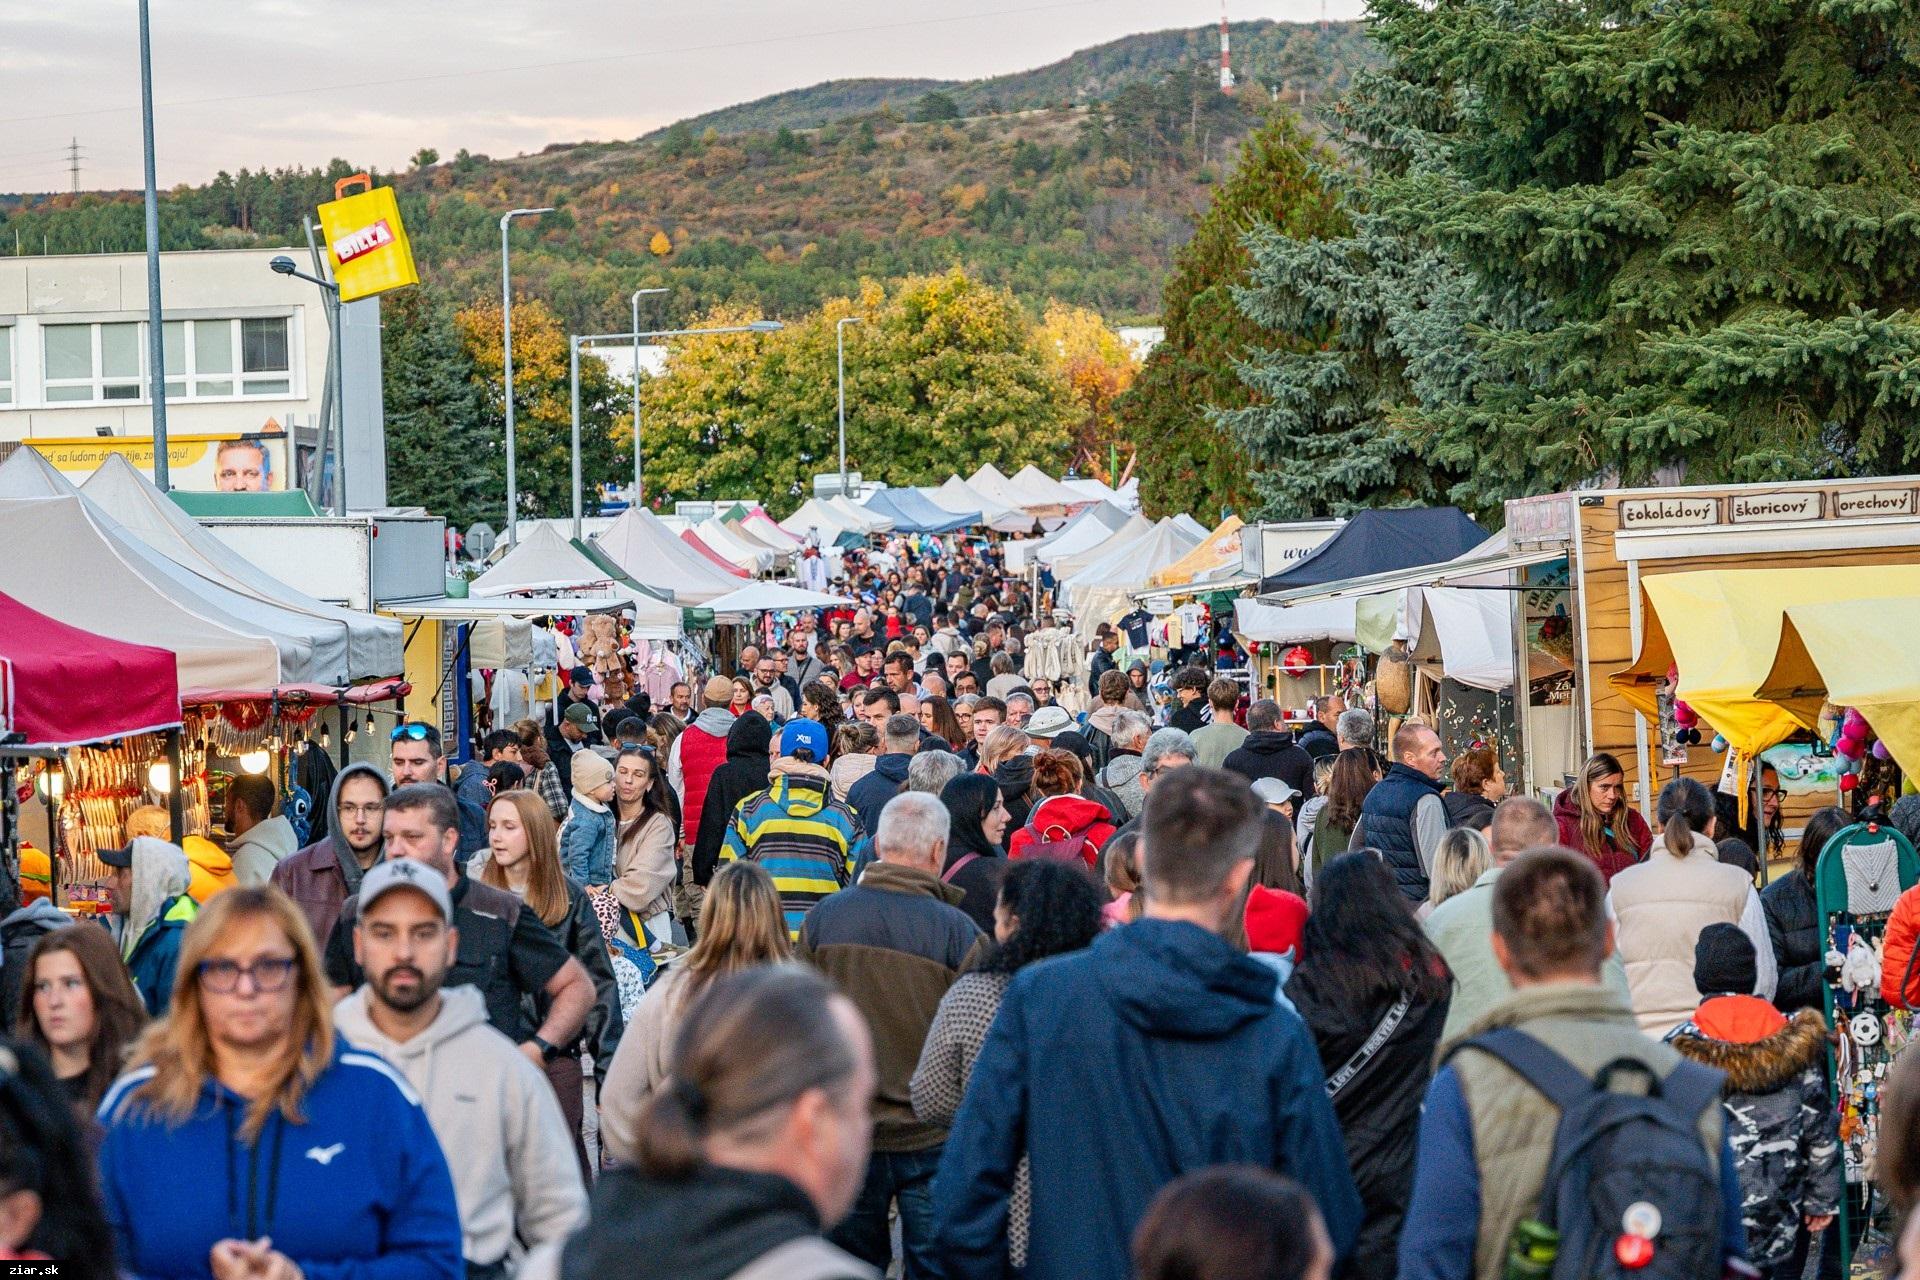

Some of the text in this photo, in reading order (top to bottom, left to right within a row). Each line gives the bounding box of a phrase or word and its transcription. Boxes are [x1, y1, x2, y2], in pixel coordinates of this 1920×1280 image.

[57, 454, 68, 463] sa
[1627, 501, 1711, 521] čokoládový
[1736, 498, 1808, 517] škoricový
[1840, 492, 1907, 511] orechový
